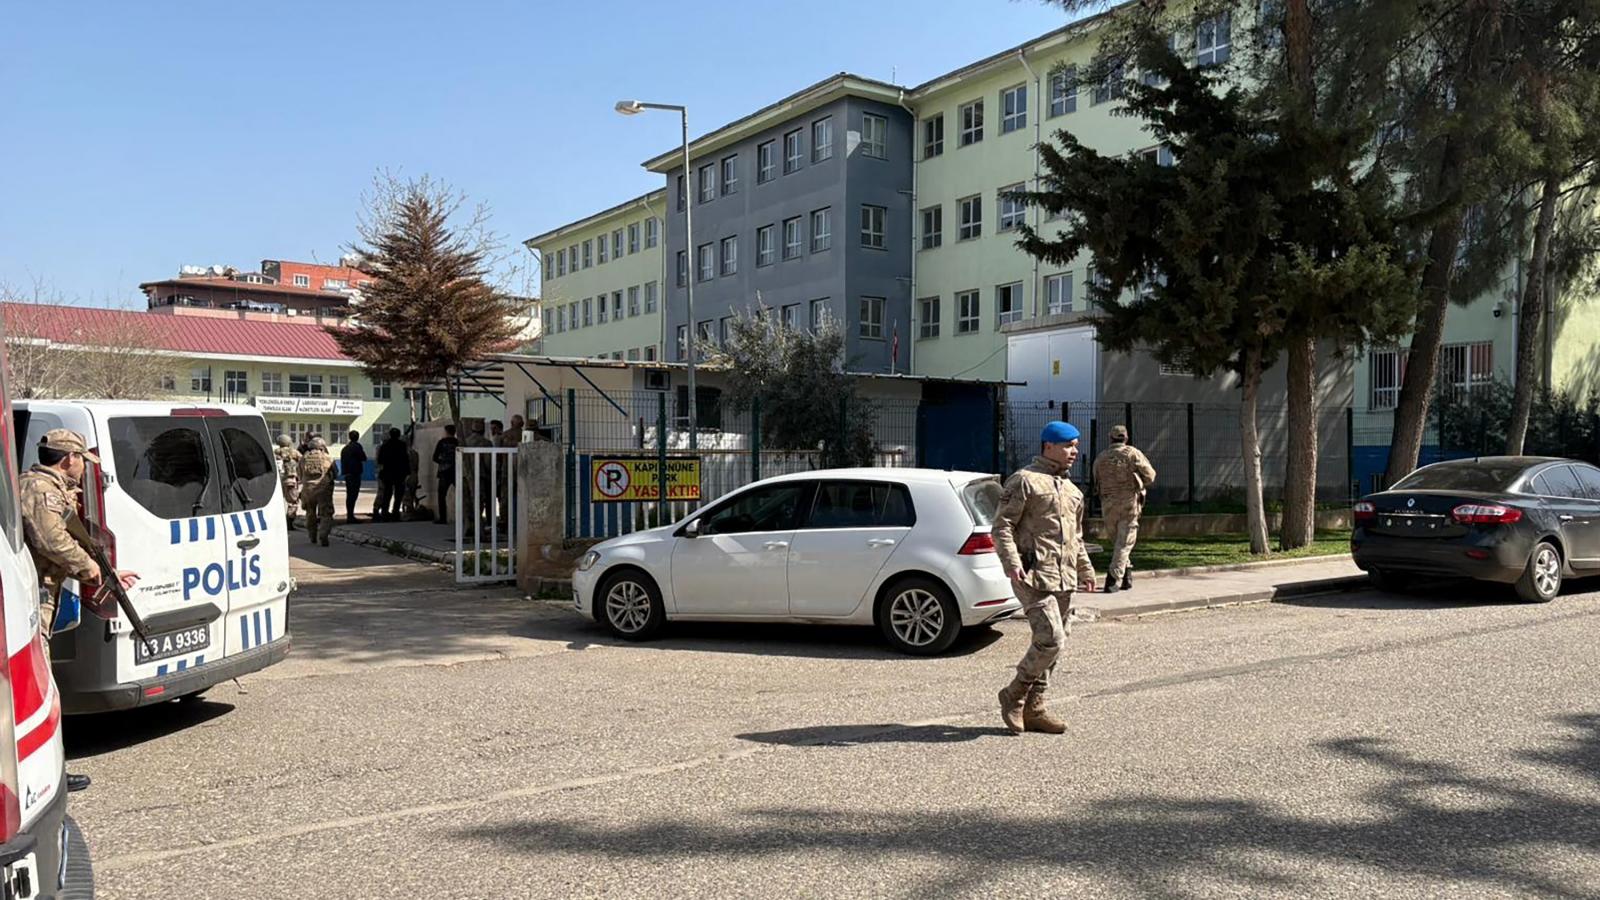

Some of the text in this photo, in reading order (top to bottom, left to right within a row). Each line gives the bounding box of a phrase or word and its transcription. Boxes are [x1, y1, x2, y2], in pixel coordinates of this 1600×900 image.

[635, 463, 658, 472] KAPI
[652, 473, 678, 481] PRK
[633, 485, 699, 497] YASKTIR
[162, 636, 173, 652] A
[176, 628, 206, 649] 9336
